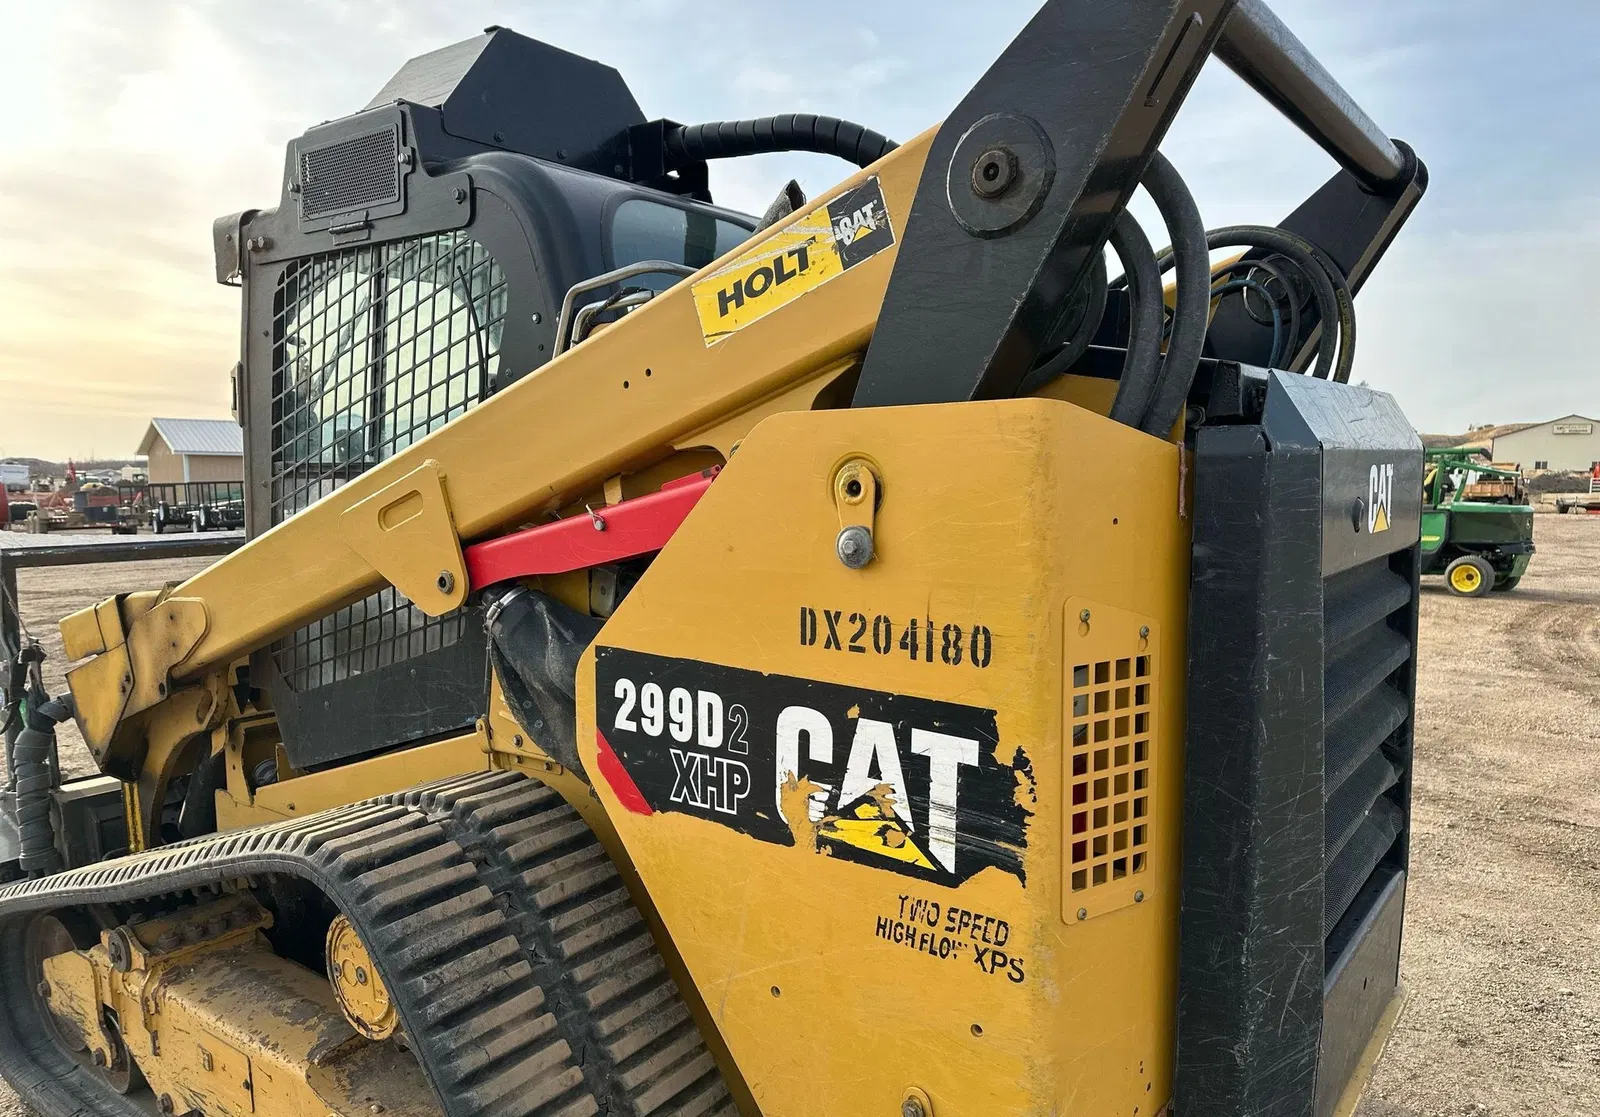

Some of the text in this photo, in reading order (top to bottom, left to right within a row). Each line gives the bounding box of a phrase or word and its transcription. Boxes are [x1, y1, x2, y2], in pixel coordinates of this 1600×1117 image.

[717, 201, 877, 318] HOLT CAT
[1368, 463, 1394, 534] CAT
[800, 606, 992, 668] DX204180
[669, 748, 751, 815] XHP
[775, 705, 980, 874] CAT
[875, 915, 917, 948] HIGH
[973, 943, 1025, 984] XPS
[898, 894, 1009, 947] TWO SPEED
